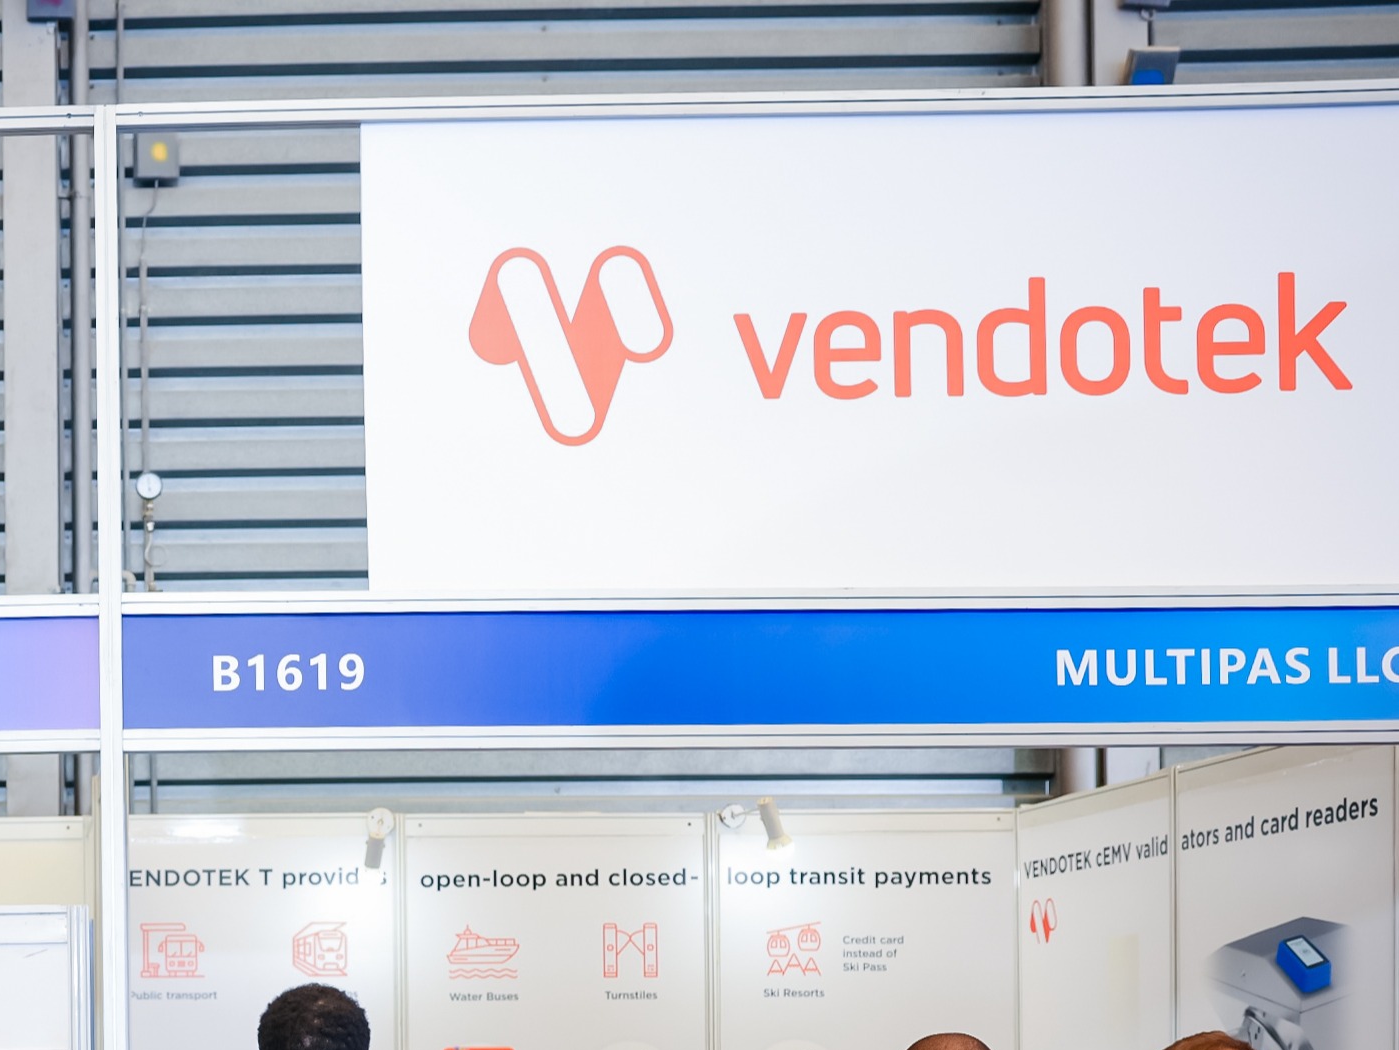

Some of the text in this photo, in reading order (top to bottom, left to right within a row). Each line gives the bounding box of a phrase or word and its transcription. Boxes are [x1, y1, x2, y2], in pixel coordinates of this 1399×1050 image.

[733, 272, 1353, 400] vendotek
[212, 652, 365, 692] B1619
[1055, 646, 1312, 687] MULTIPAS
[1024, 796, 1379, 880] VENDOTEK cEMV valid ators and card readers
[129, 866, 992, 891] ENDOTEK T provid open-loop and closed- loop transit payments
[842, 935, 905, 945] Credit card
[842, 948, 898, 958] instead of
[842, 962, 888, 972] Ski Pass
[166, 990, 218, 1001] transport
[449, 991, 519, 1002] Water Buses
[604, 990, 658, 1001] Turnstiles
[763, 988, 826, 998] Ski Resorts
